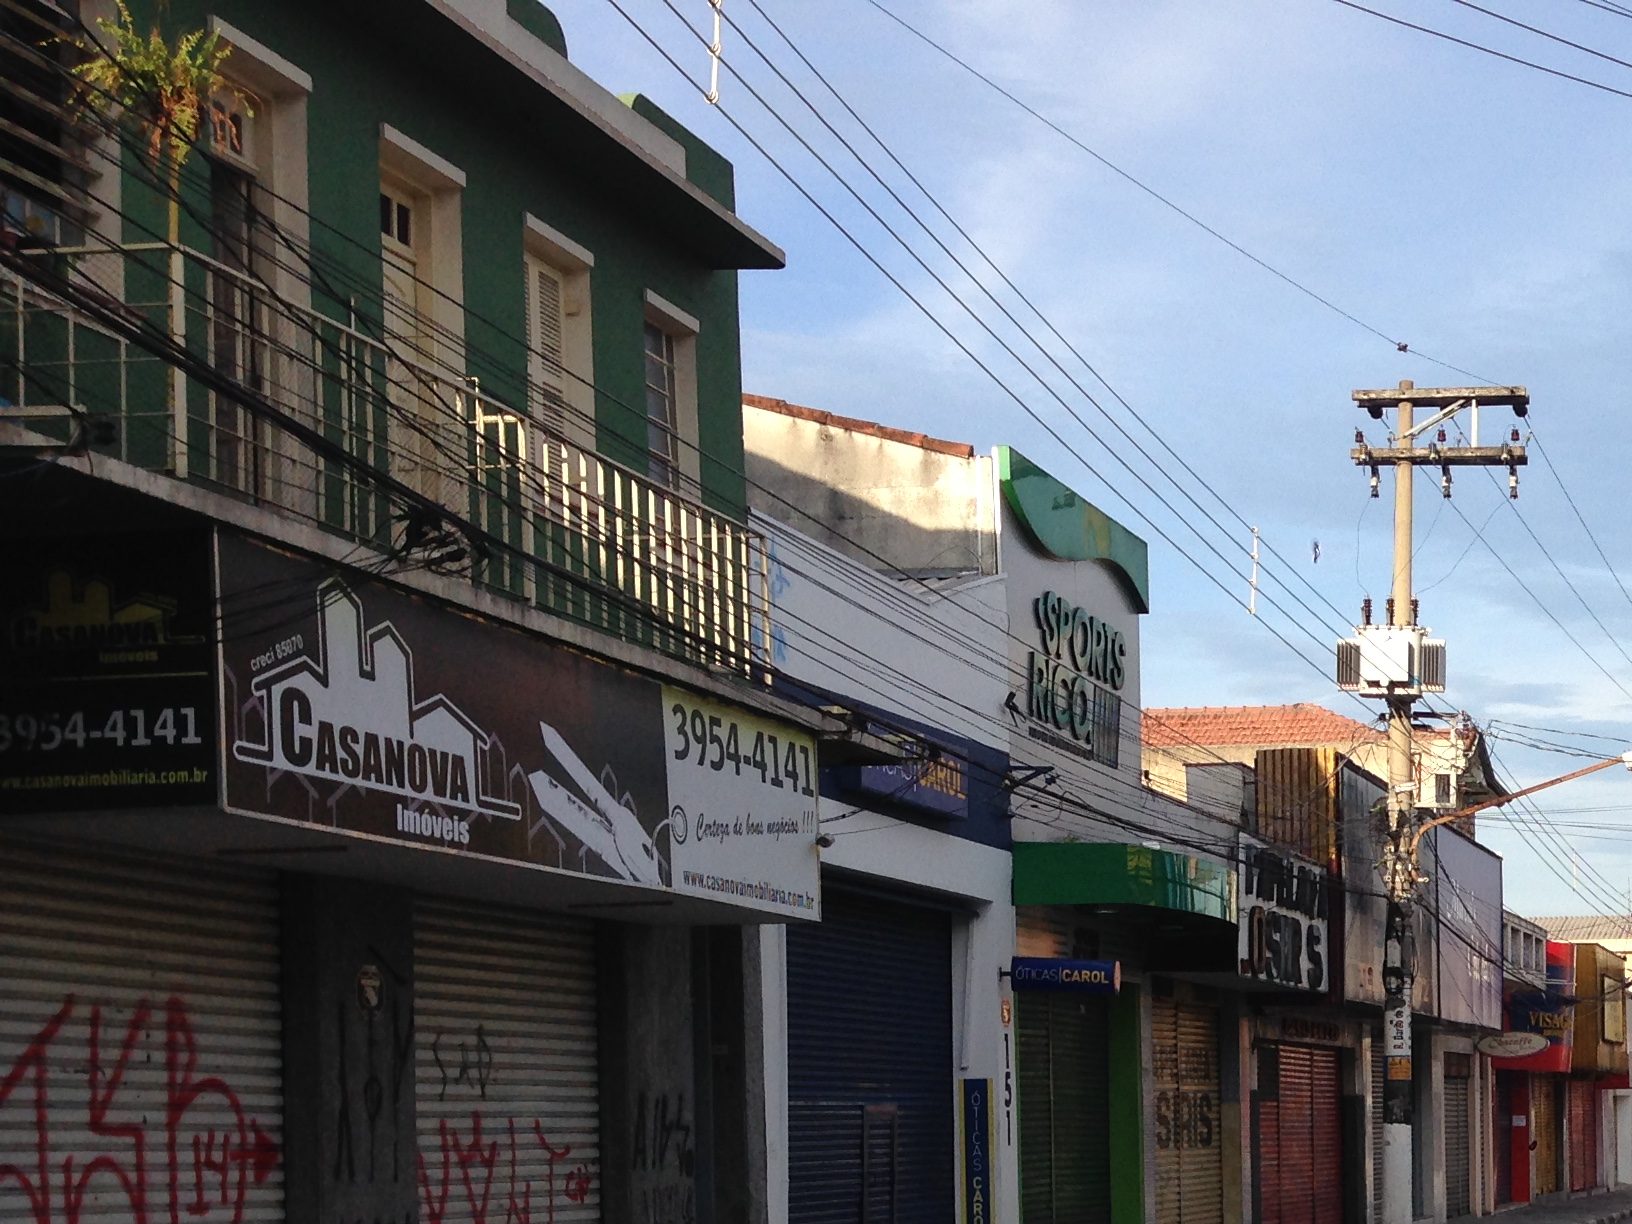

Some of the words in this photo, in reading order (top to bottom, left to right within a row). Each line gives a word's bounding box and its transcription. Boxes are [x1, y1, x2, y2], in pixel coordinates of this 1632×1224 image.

[1033, 590, 1126, 691] SPORTS
[0, 706, 202, 752] 3954-4141
[279, 686, 471, 804] CASANOVA
[671, 703, 814, 798] 3954-4141
[396, 803, 471, 844] Imóveis
[733, 816, 744, 837] de
[766, 817, 799, 842] negócios
[683, 870, 815, 911] www.casanovaimobiliaria.com.br
[1015, 965, 1058, 981] ÓTICAS
[1062, 968, 1110, 985] CAROL
[1004, 1033, 1012, 1147] 151
[970, 1090, 983, 1172] ÓTICAS
